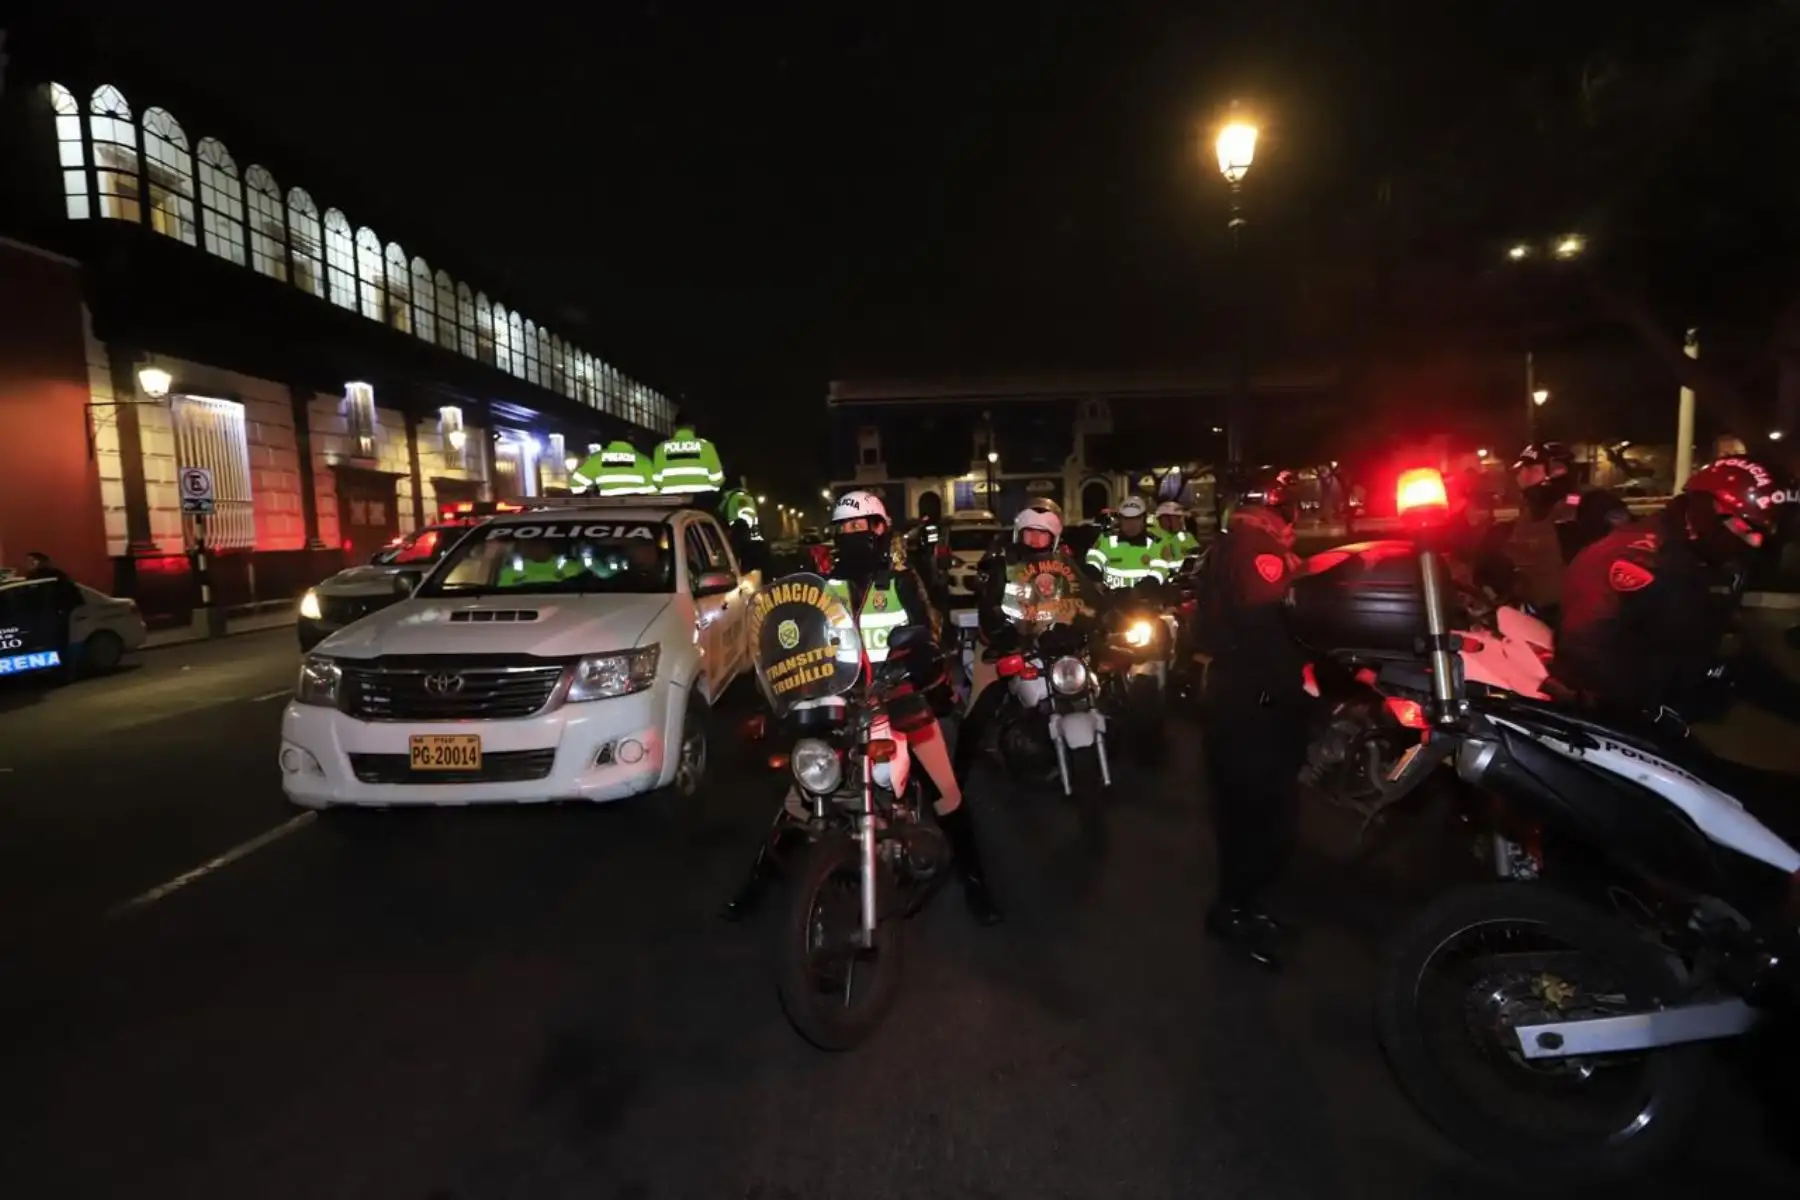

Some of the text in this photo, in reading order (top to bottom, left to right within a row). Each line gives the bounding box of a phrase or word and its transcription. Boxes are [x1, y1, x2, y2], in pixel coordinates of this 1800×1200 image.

[663, 440, 701, 455] POLICIA
[485, 525, 653, 541] POLICIA
[765, 644, 839, 681] TRANSITO
[773, 662, 835, 696] TRUJILLO
[413, 746, 476, 765] PG-20014
